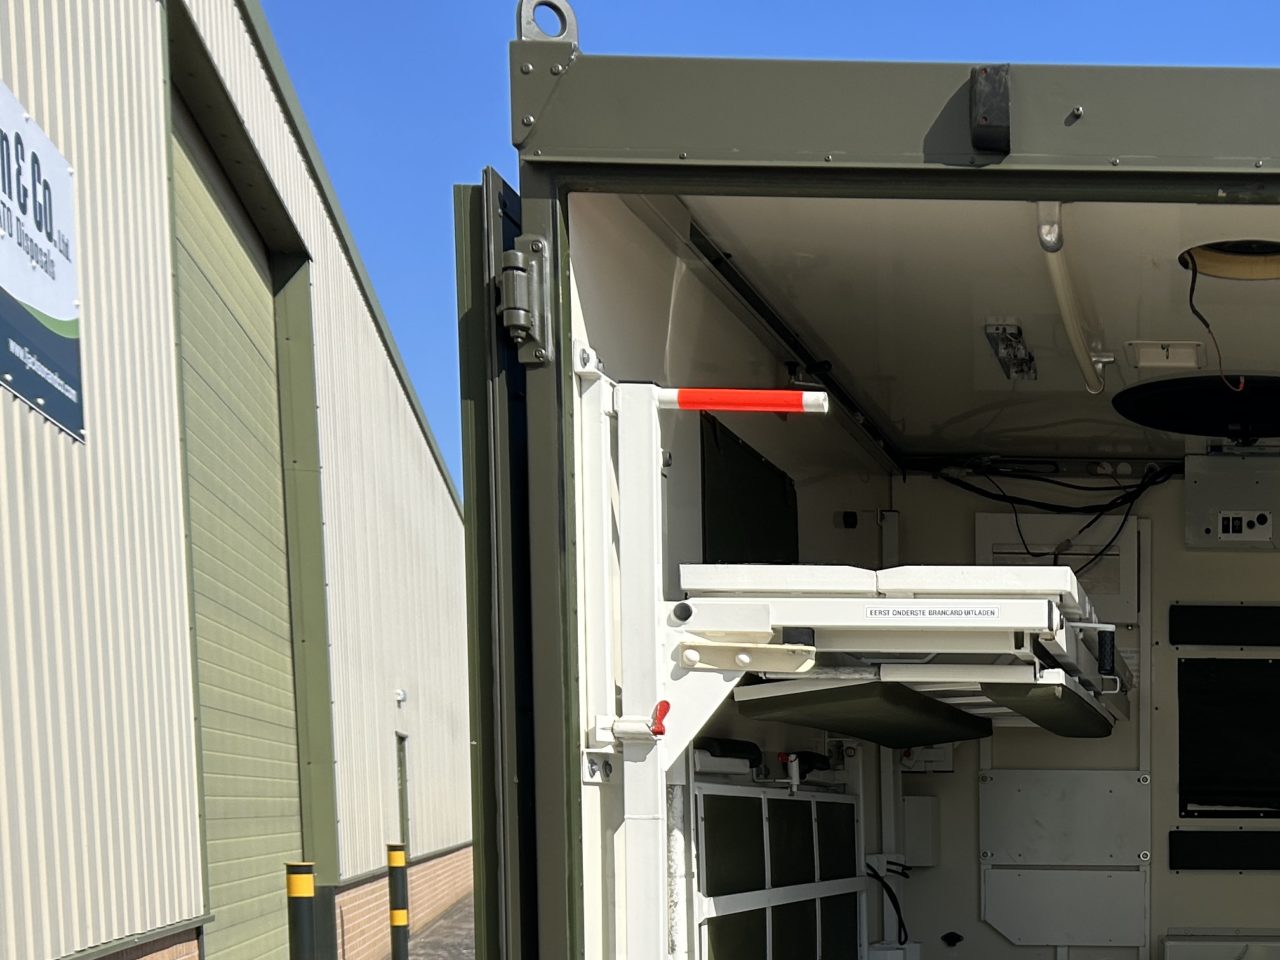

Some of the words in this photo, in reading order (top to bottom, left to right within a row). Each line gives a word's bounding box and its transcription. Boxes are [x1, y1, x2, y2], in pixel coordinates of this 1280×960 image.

[0, 200, 13, 238] TO
[15, 215, 55, 281] Disposals
[869, 609, 890, 617] EERST
[892, 609, 926, 617] ONDERSTE
[928, 609, 963, 617] BRANCARD
[964, 609, 995, 617] UITLADEN
